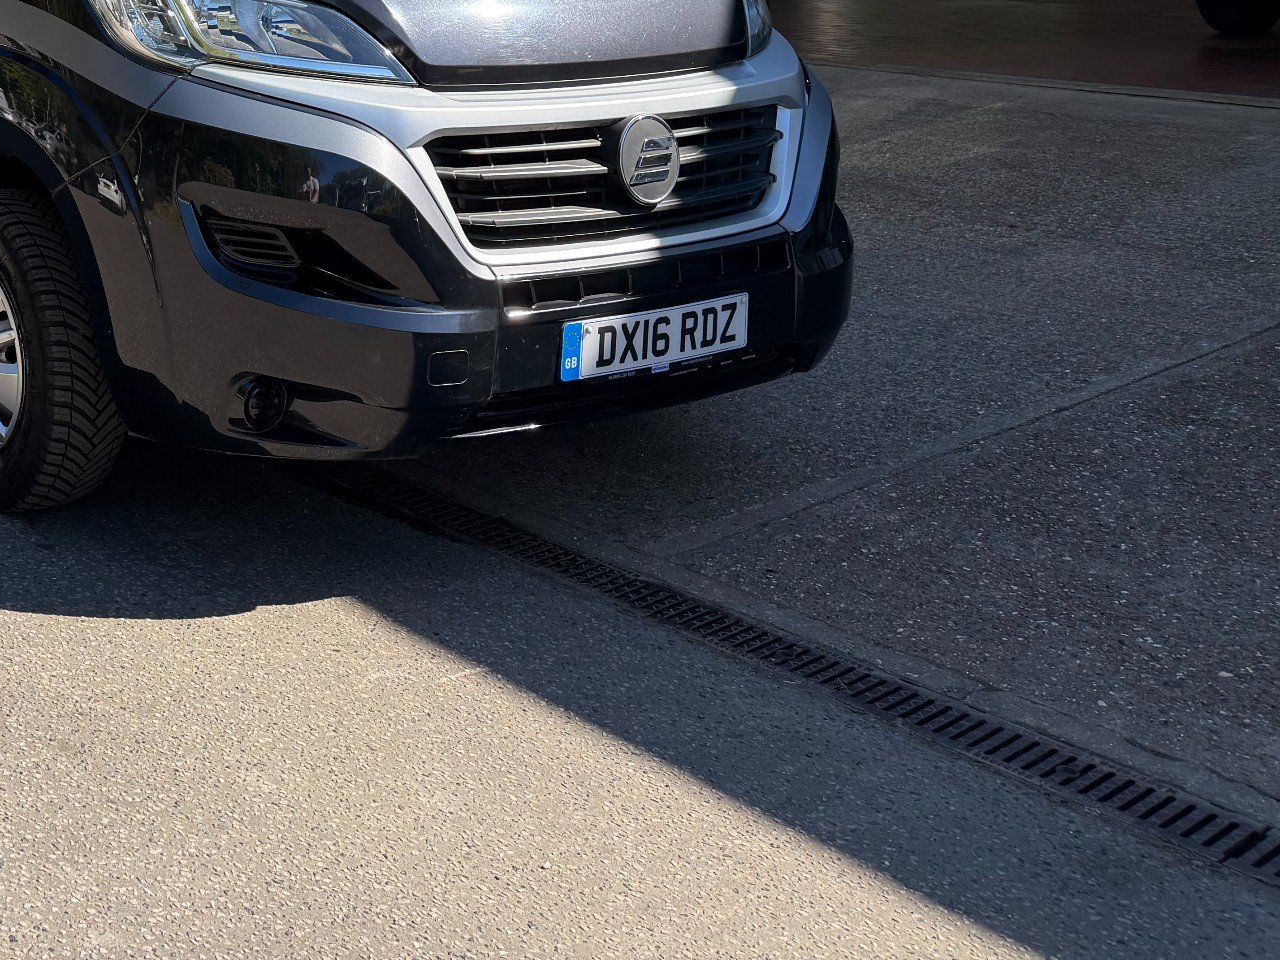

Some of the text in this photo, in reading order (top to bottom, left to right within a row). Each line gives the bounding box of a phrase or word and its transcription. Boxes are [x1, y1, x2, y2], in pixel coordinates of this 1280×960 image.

[596, 301, 738, 368] DX16 RDZ
[565, 356, 578, 369] GB
